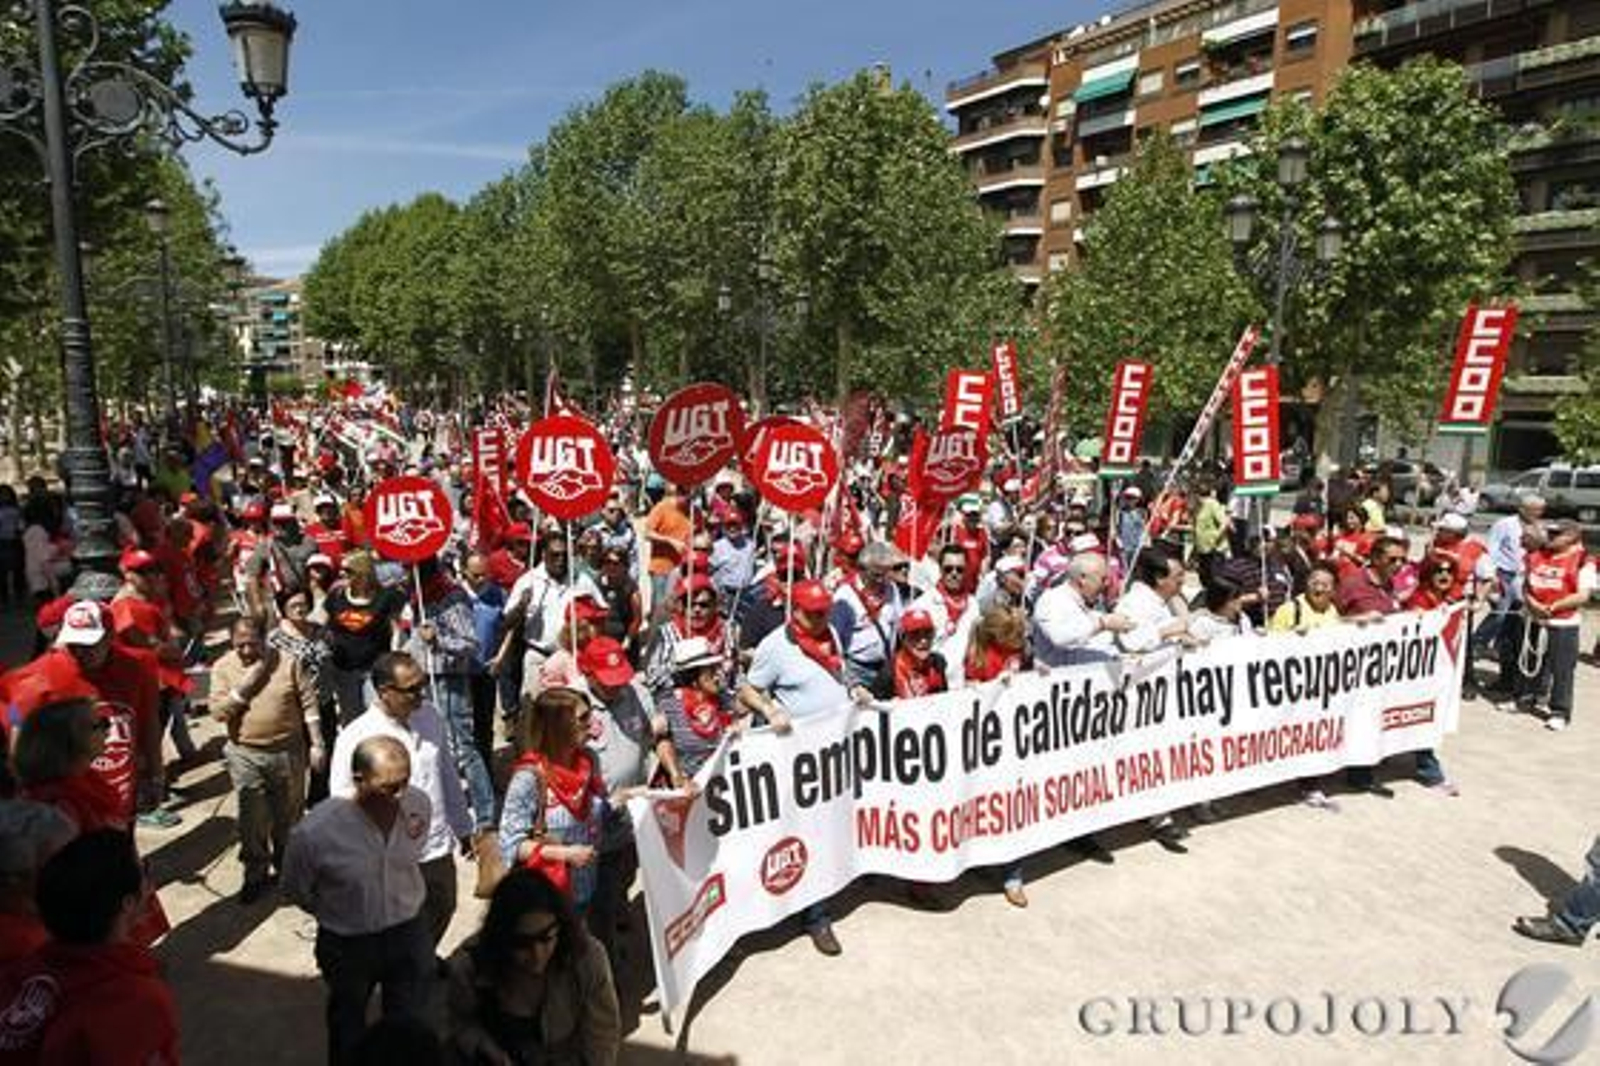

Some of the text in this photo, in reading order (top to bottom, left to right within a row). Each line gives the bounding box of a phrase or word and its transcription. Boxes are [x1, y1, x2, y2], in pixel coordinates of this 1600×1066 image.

[995, 343, 1018, 415] CCOO
[1452, 309, 1505, 420] CCOO
[664, 399, 729, 445] UGT
[953, 374, 986, 429] CC
[1108, 364, 1147, 463] CCOO
[1241, 370, 1272, 480] CCOO
[530, 436, 596, 475] UGT
[767, 439, 825, 474] UGT
[926, 431, 977, 463] UGT
[377, 490, 435, 525] UGT
[705, 623, 1439, 838] sin empleo de calidad no hay recuperación
[857, 716, 1346, 853] MÁS COHESIÓN SOCIAL PARA MÁS DEMOCRACIA
